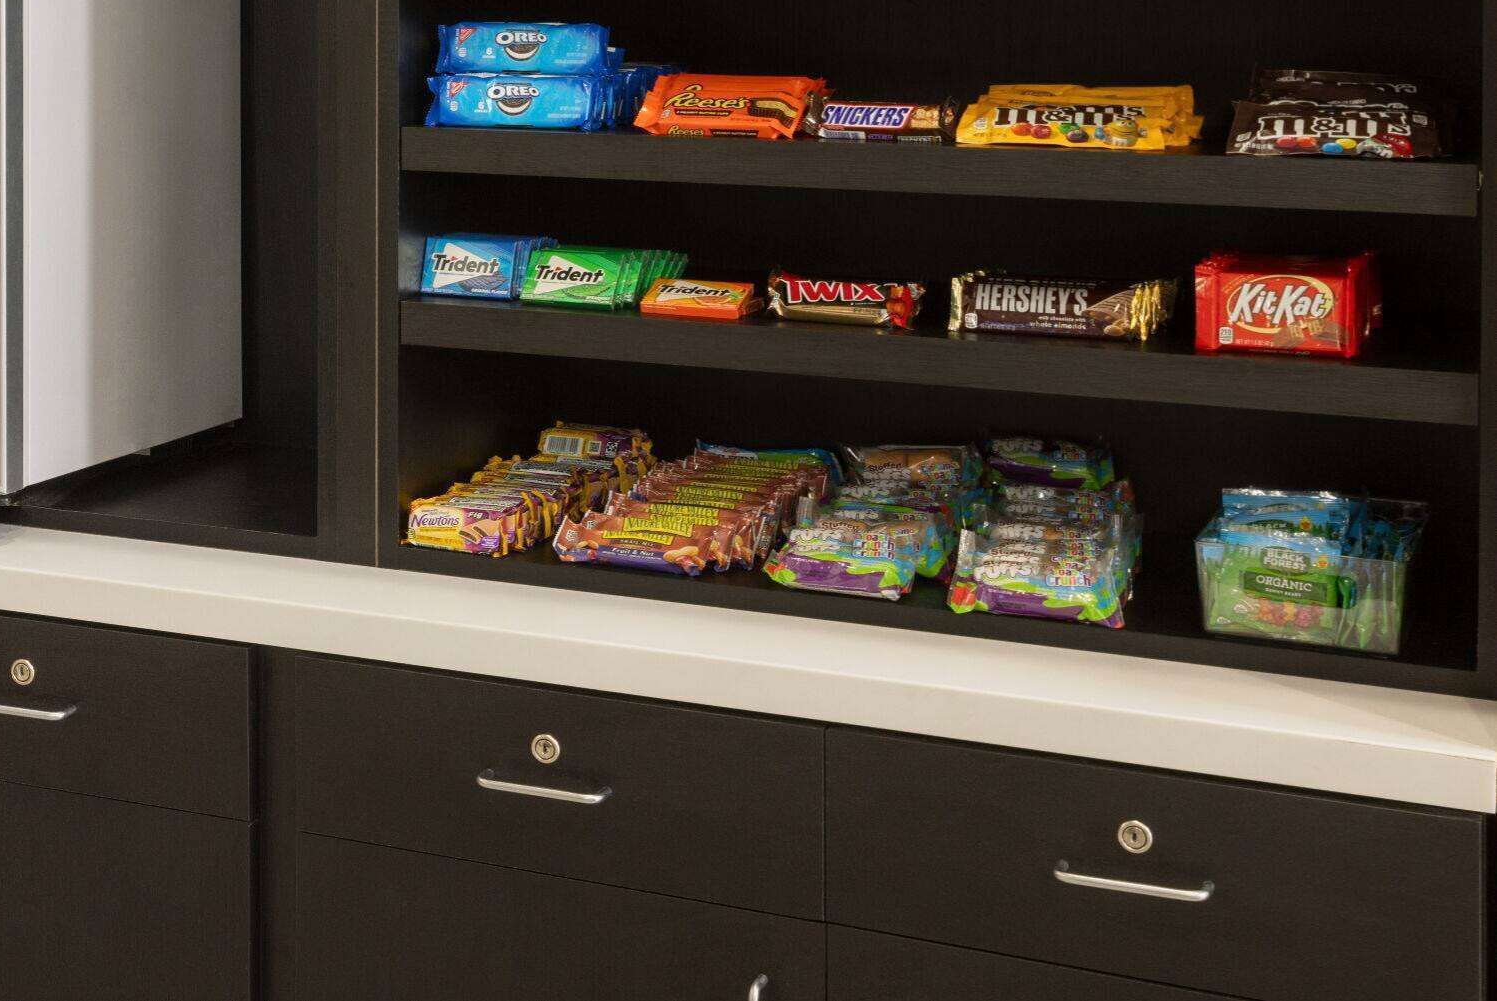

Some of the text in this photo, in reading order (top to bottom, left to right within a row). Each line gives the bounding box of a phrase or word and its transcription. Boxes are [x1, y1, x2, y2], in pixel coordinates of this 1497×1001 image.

[495, 31, 548, 45] OREO
[486, 85, 541, 100] OREO
[663, 89, 750, 109] Reese's
[821, 105, 911, 127] SNICKERS
[433, 253, 500, 274] Trident
[535, 264, 605, 283] Trident
[658, 284, 731, 297] Trident
[782, 276, 886, 303] TWIX
[975, 283, 1089, 316] HERSHEY'S
[1030, 320, 1087, 330] whole almonds
[410, 513, 460, 528] Newtons
[612, 547, 631, 555] Fruit
[1255, 574, 1313, 592] ORGANIC
